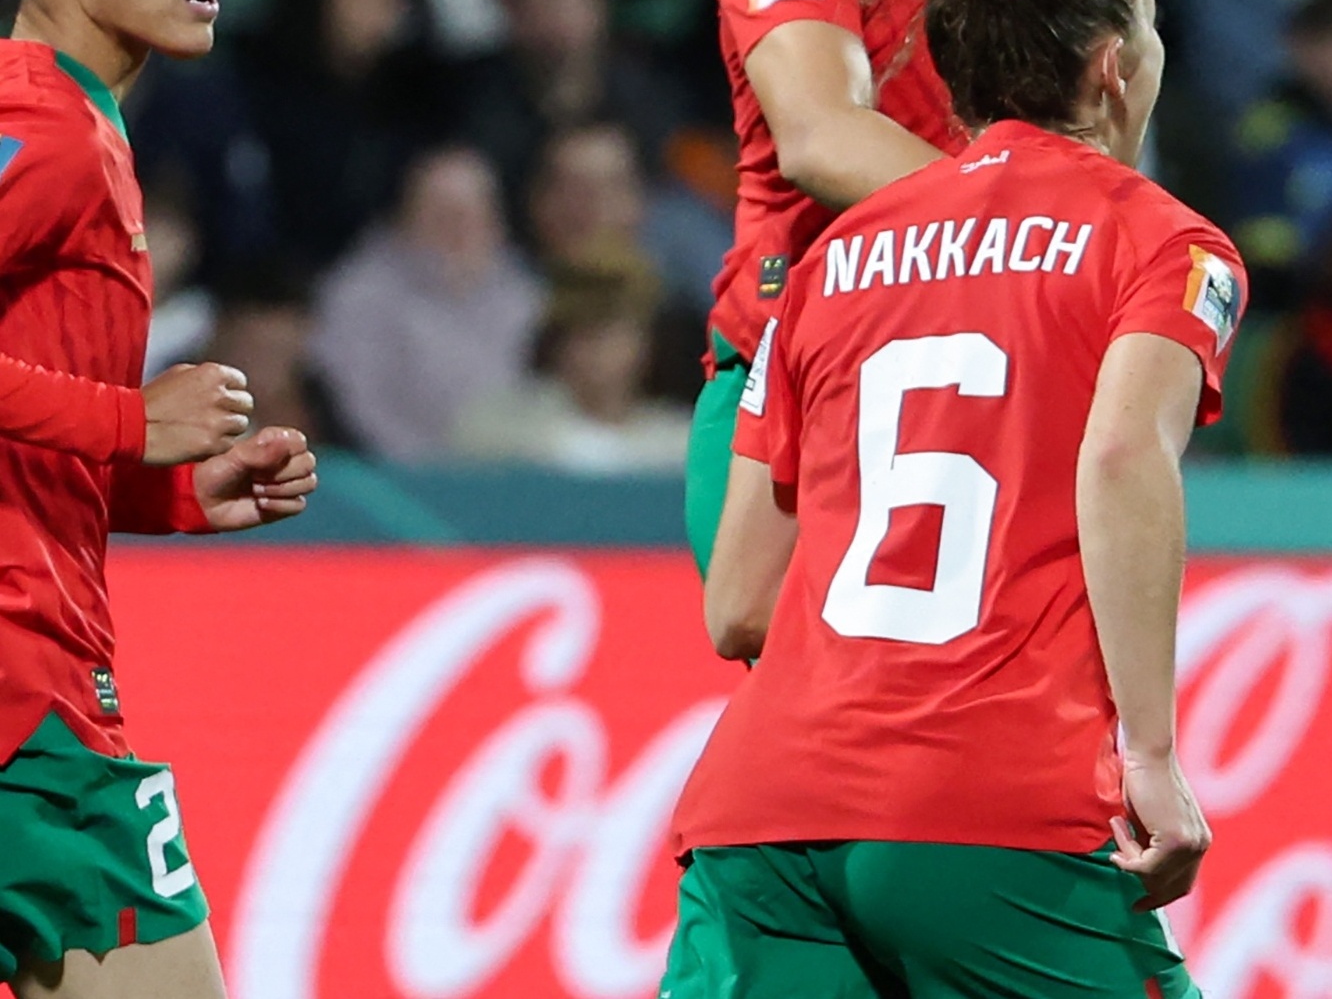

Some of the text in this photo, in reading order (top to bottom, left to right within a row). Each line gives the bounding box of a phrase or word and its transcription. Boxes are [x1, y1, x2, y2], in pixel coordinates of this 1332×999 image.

[823, 216, 1093, 297] NAKKACH
[820, 332, 1008, 645] 6
[135, 769, 196, 898] 2
